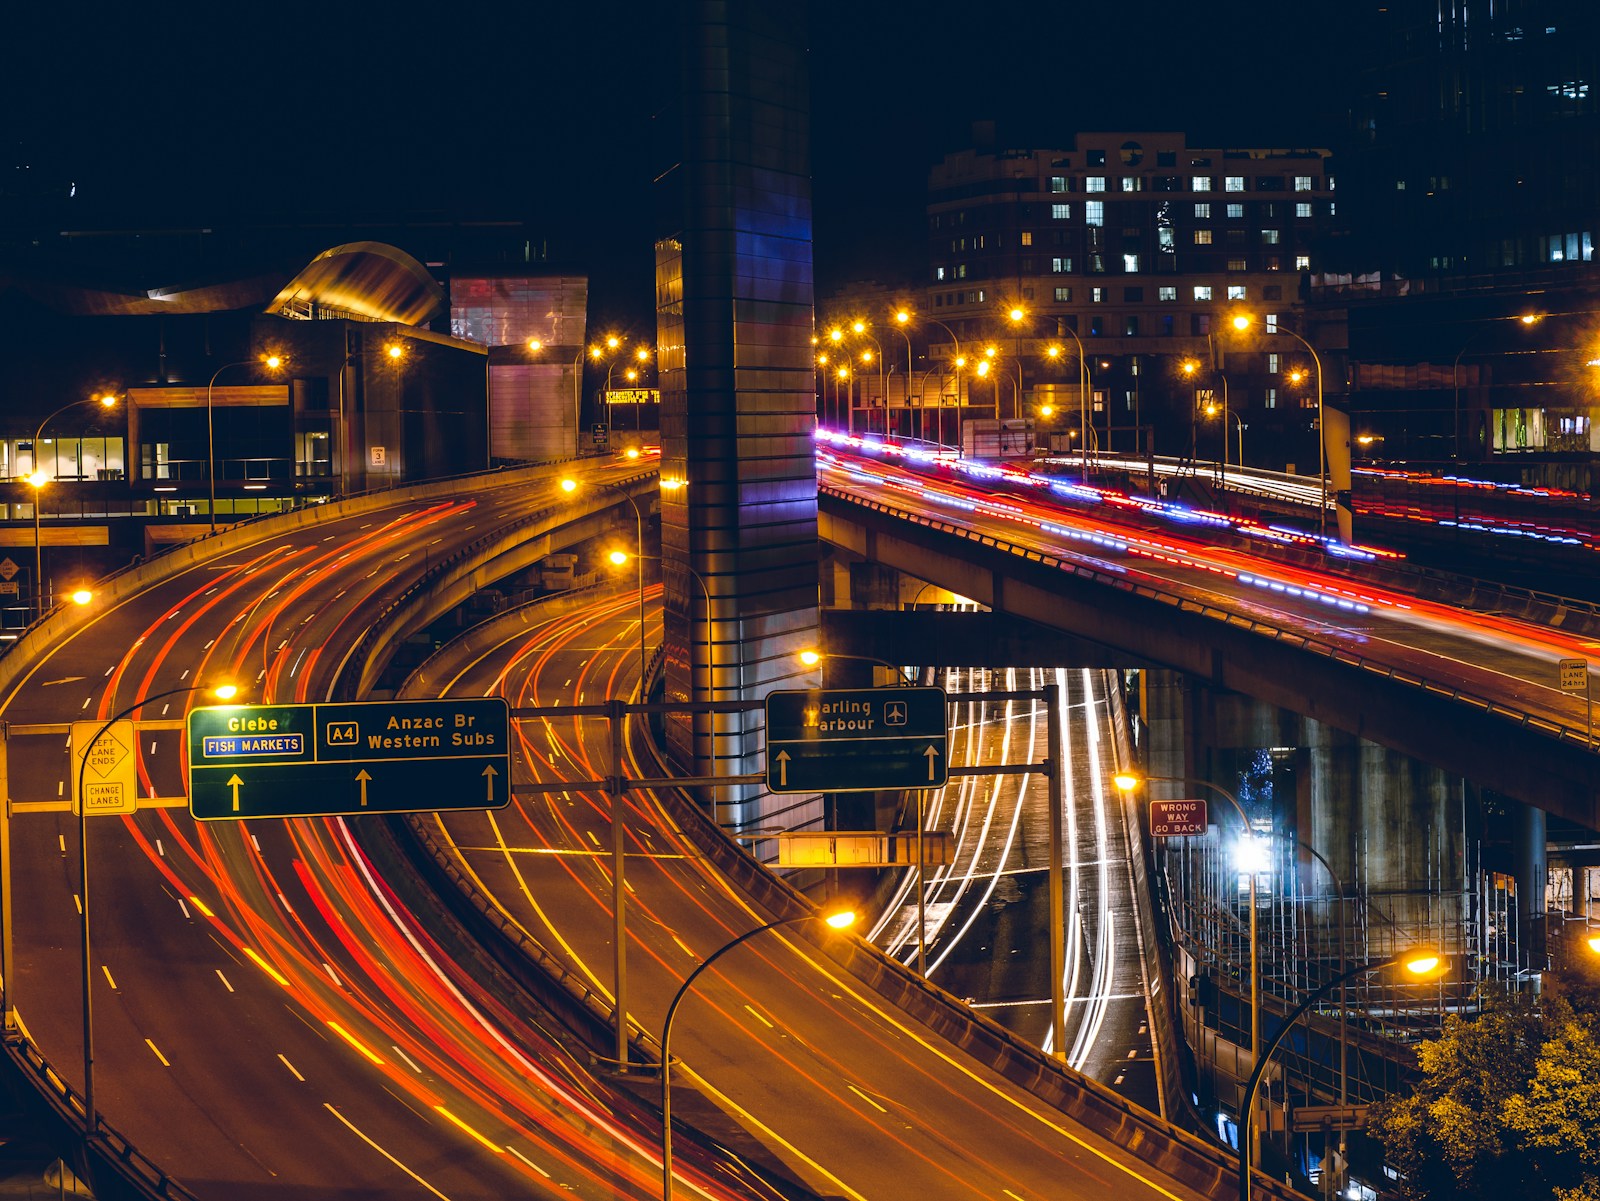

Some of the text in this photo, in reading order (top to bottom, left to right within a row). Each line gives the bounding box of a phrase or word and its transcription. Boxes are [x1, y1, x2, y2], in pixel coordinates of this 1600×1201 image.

[228, 717, 278, 732] Glebe
[387, 714, 476, 730] Anzac Br
[807, 718, 874, 731] arbour
[332, 727, 354, 740] A4
[208, 739, 299, 752] FISH MARKETS
[368, 732, 494, 749] Western Subs
[1160, 804, 1196, 812] WRONG
